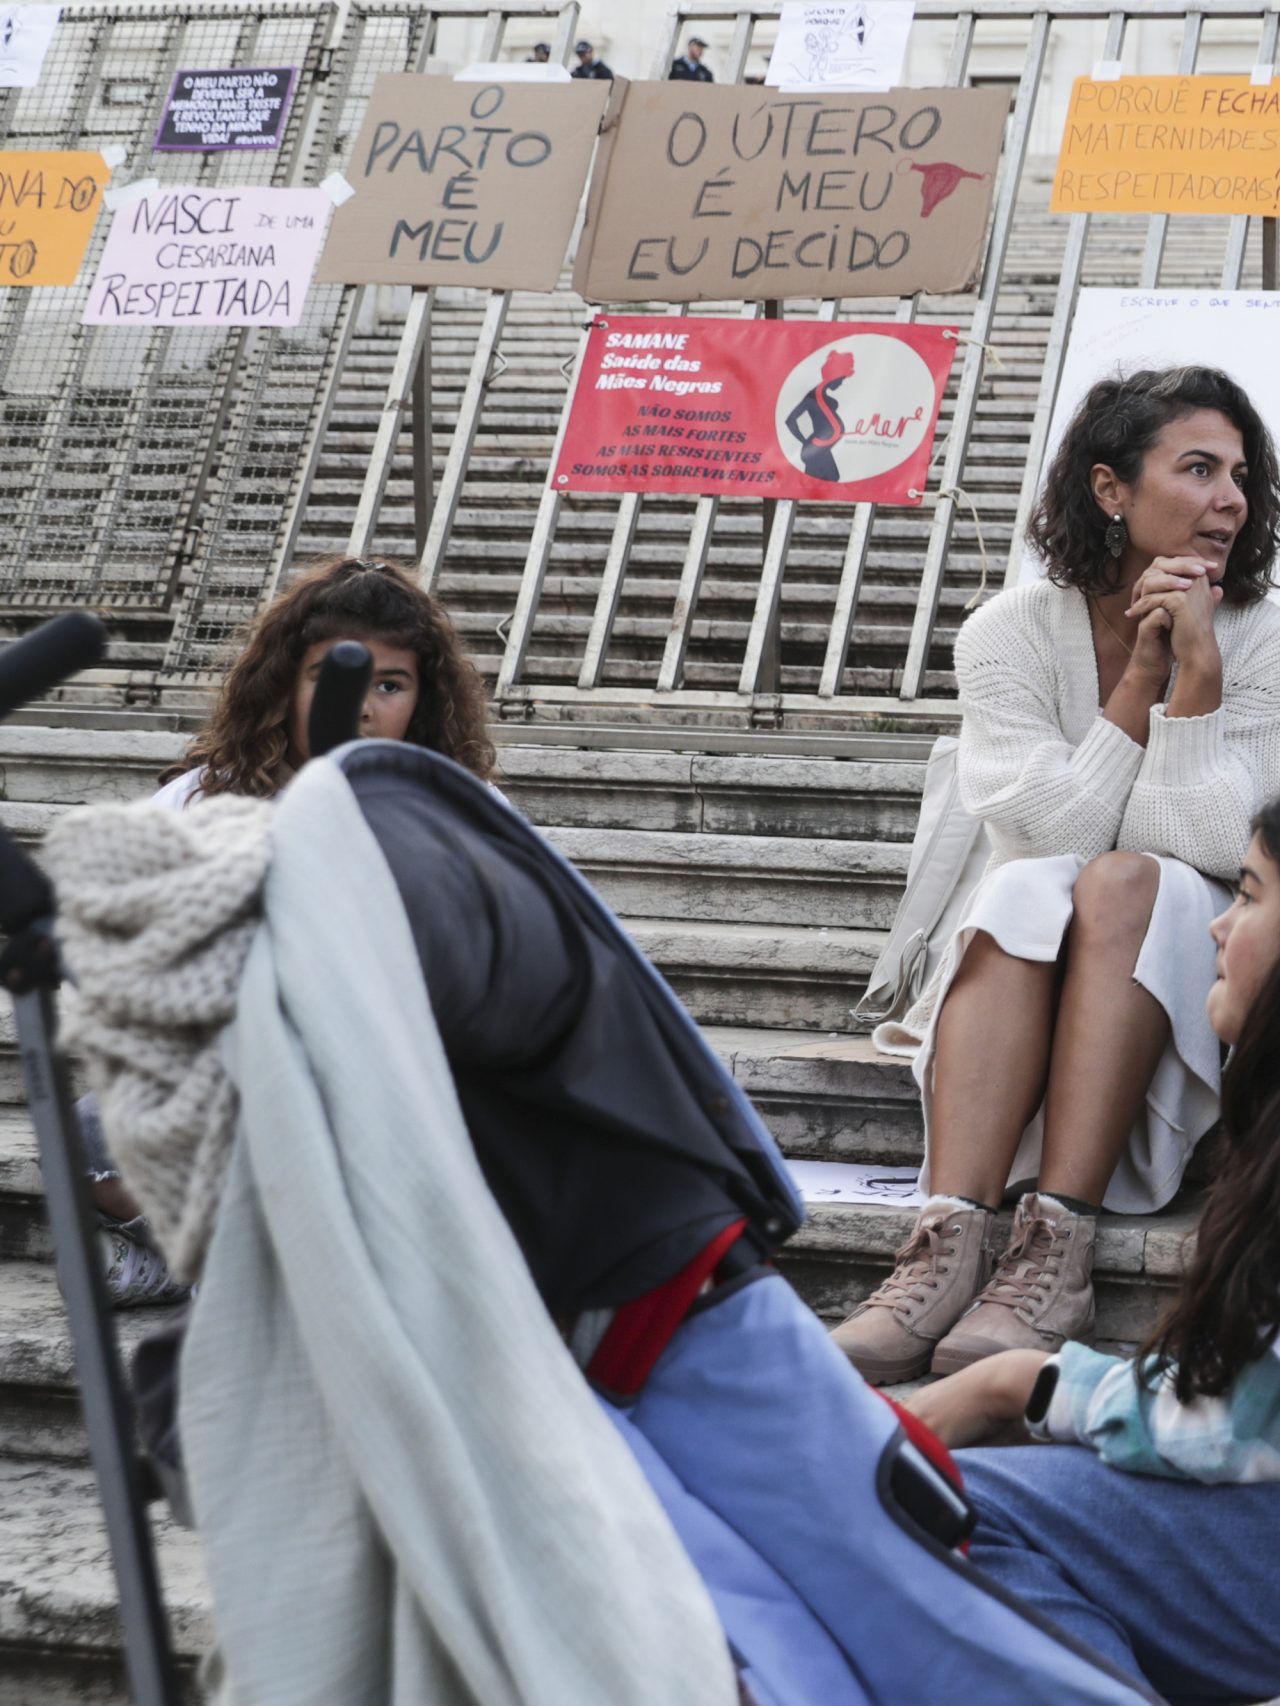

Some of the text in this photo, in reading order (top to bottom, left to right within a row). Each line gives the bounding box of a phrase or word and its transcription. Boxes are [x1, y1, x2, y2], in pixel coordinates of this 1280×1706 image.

[183, 77, 193, 88] O
[218, 75, 251, 88] PARTO
[253, 72, 278, 87] NÃO
[191, 88, 234, 100] DEVERIA
[219, 99, 247, 110] MAIS
[248, 98, 281, 109] TRISTE
[470, 84, 505, 120] O
[1074, 79, 1191, 115] PORQUÊ
[175, 121, 262, 133] TENHO DA MINHA
[181, 110, 248, 122] REVOLTANTE
[249, 110, 271, 122] QUE
[666, 100, 942, 168] O ÚTERO
[1067, 122, 1278, 155] MATERNIDADES
[364, 121, 553, 177] PARTO
[441, 170, 479, 210] É
[691, 165, 894, 219] É MEU
[132, 194, 315, 235] NASCI DE UMA
[389, 219, 504, 264] MEU
[156, 242, 277, 269] CESARIANA
[627, 234, 710, 281] EU
[98, 273, 291, 318] RESPEITADA
[605, 332, 690, 351] SAMANE
[600, 352, 702, 372] Saúde das
[594, 373, 723, 396] Mães Negras
[637, 403, 732, 423] NÃO SOMOS
[622, 424, 747, 444] AS MAIS FORTES
[596, 444, 762, 464] AS MAIS RESISTENTES
[571, 463, 776, 483] SOMOS AS SOBREVIVENTES
